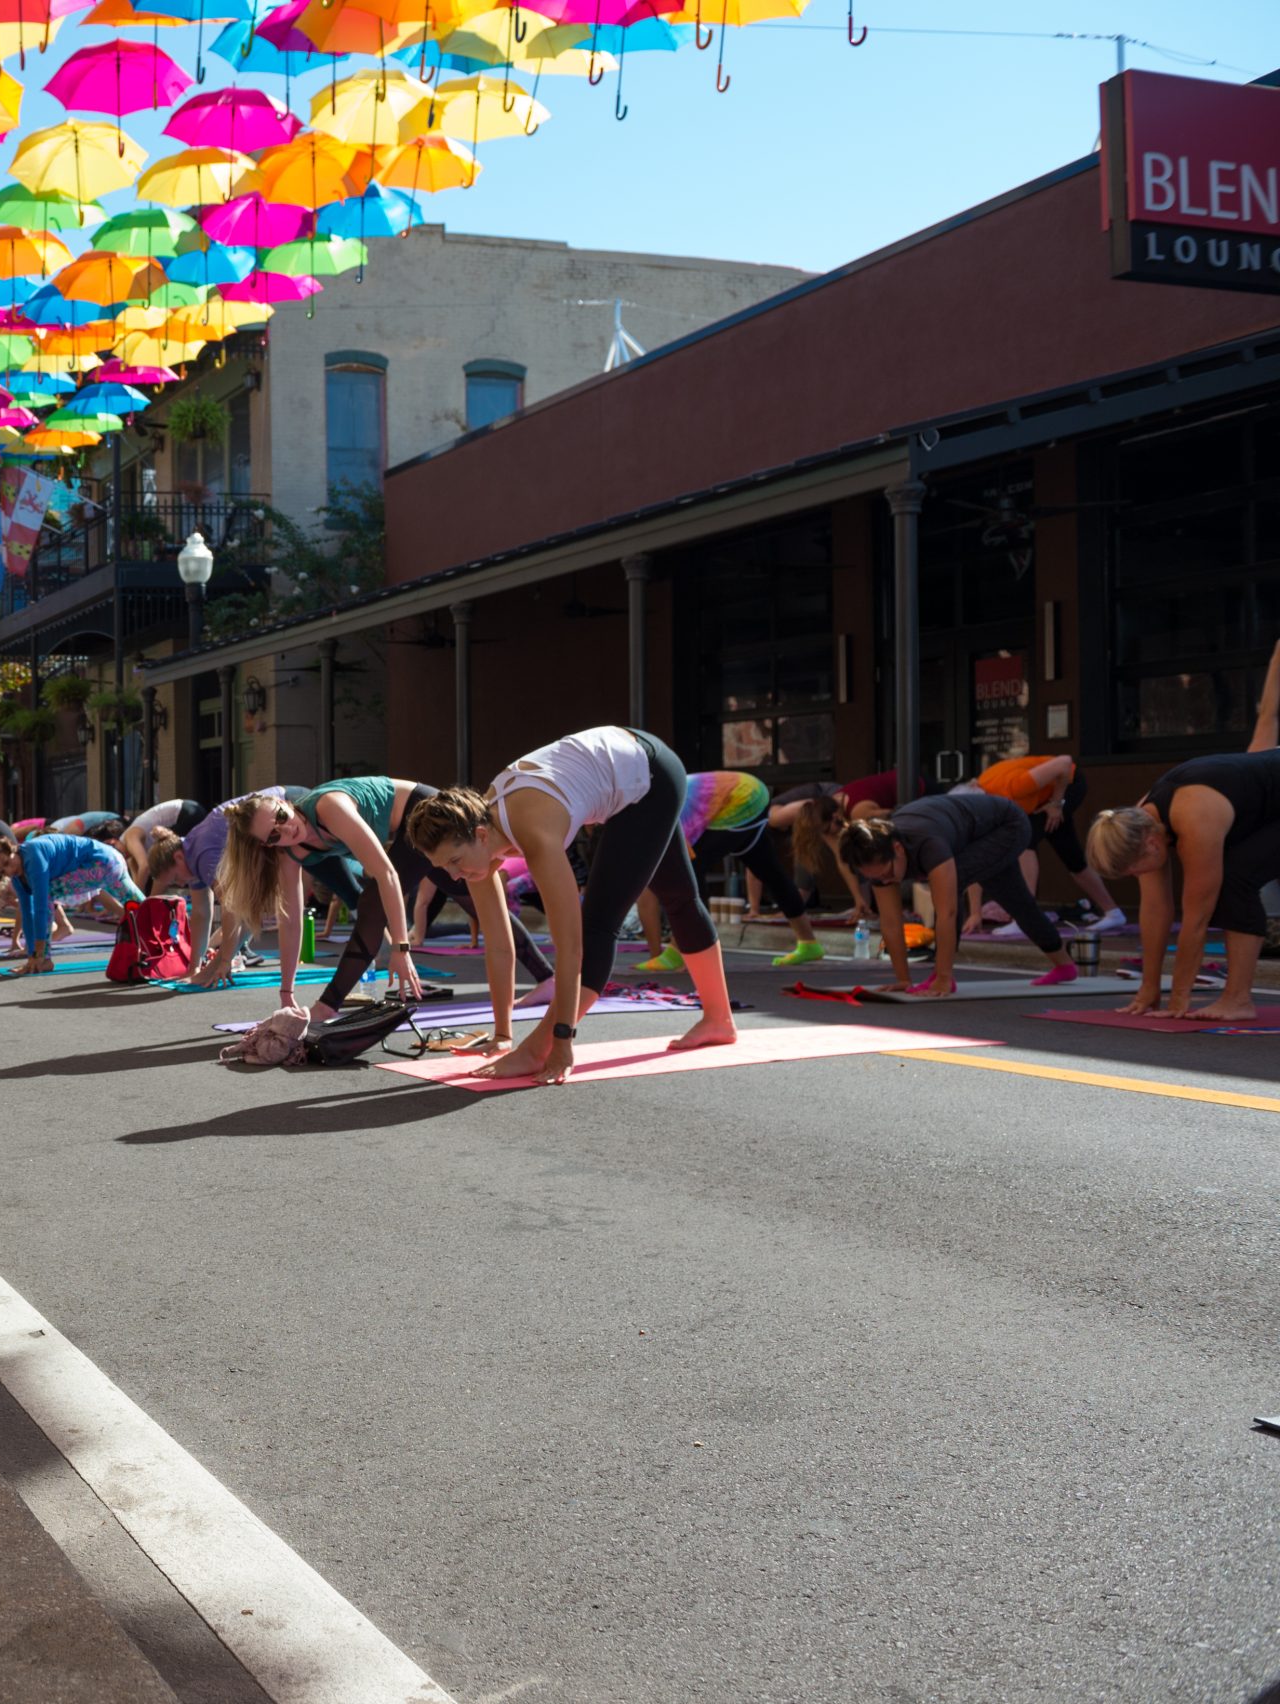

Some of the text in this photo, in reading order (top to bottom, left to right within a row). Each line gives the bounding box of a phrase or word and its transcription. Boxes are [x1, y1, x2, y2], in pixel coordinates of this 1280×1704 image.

[1143, 152, 1278, 224] BLEN
[976, 679, 1021, 700] BLEND
[976, 697, 1021, 710] LOUNG
